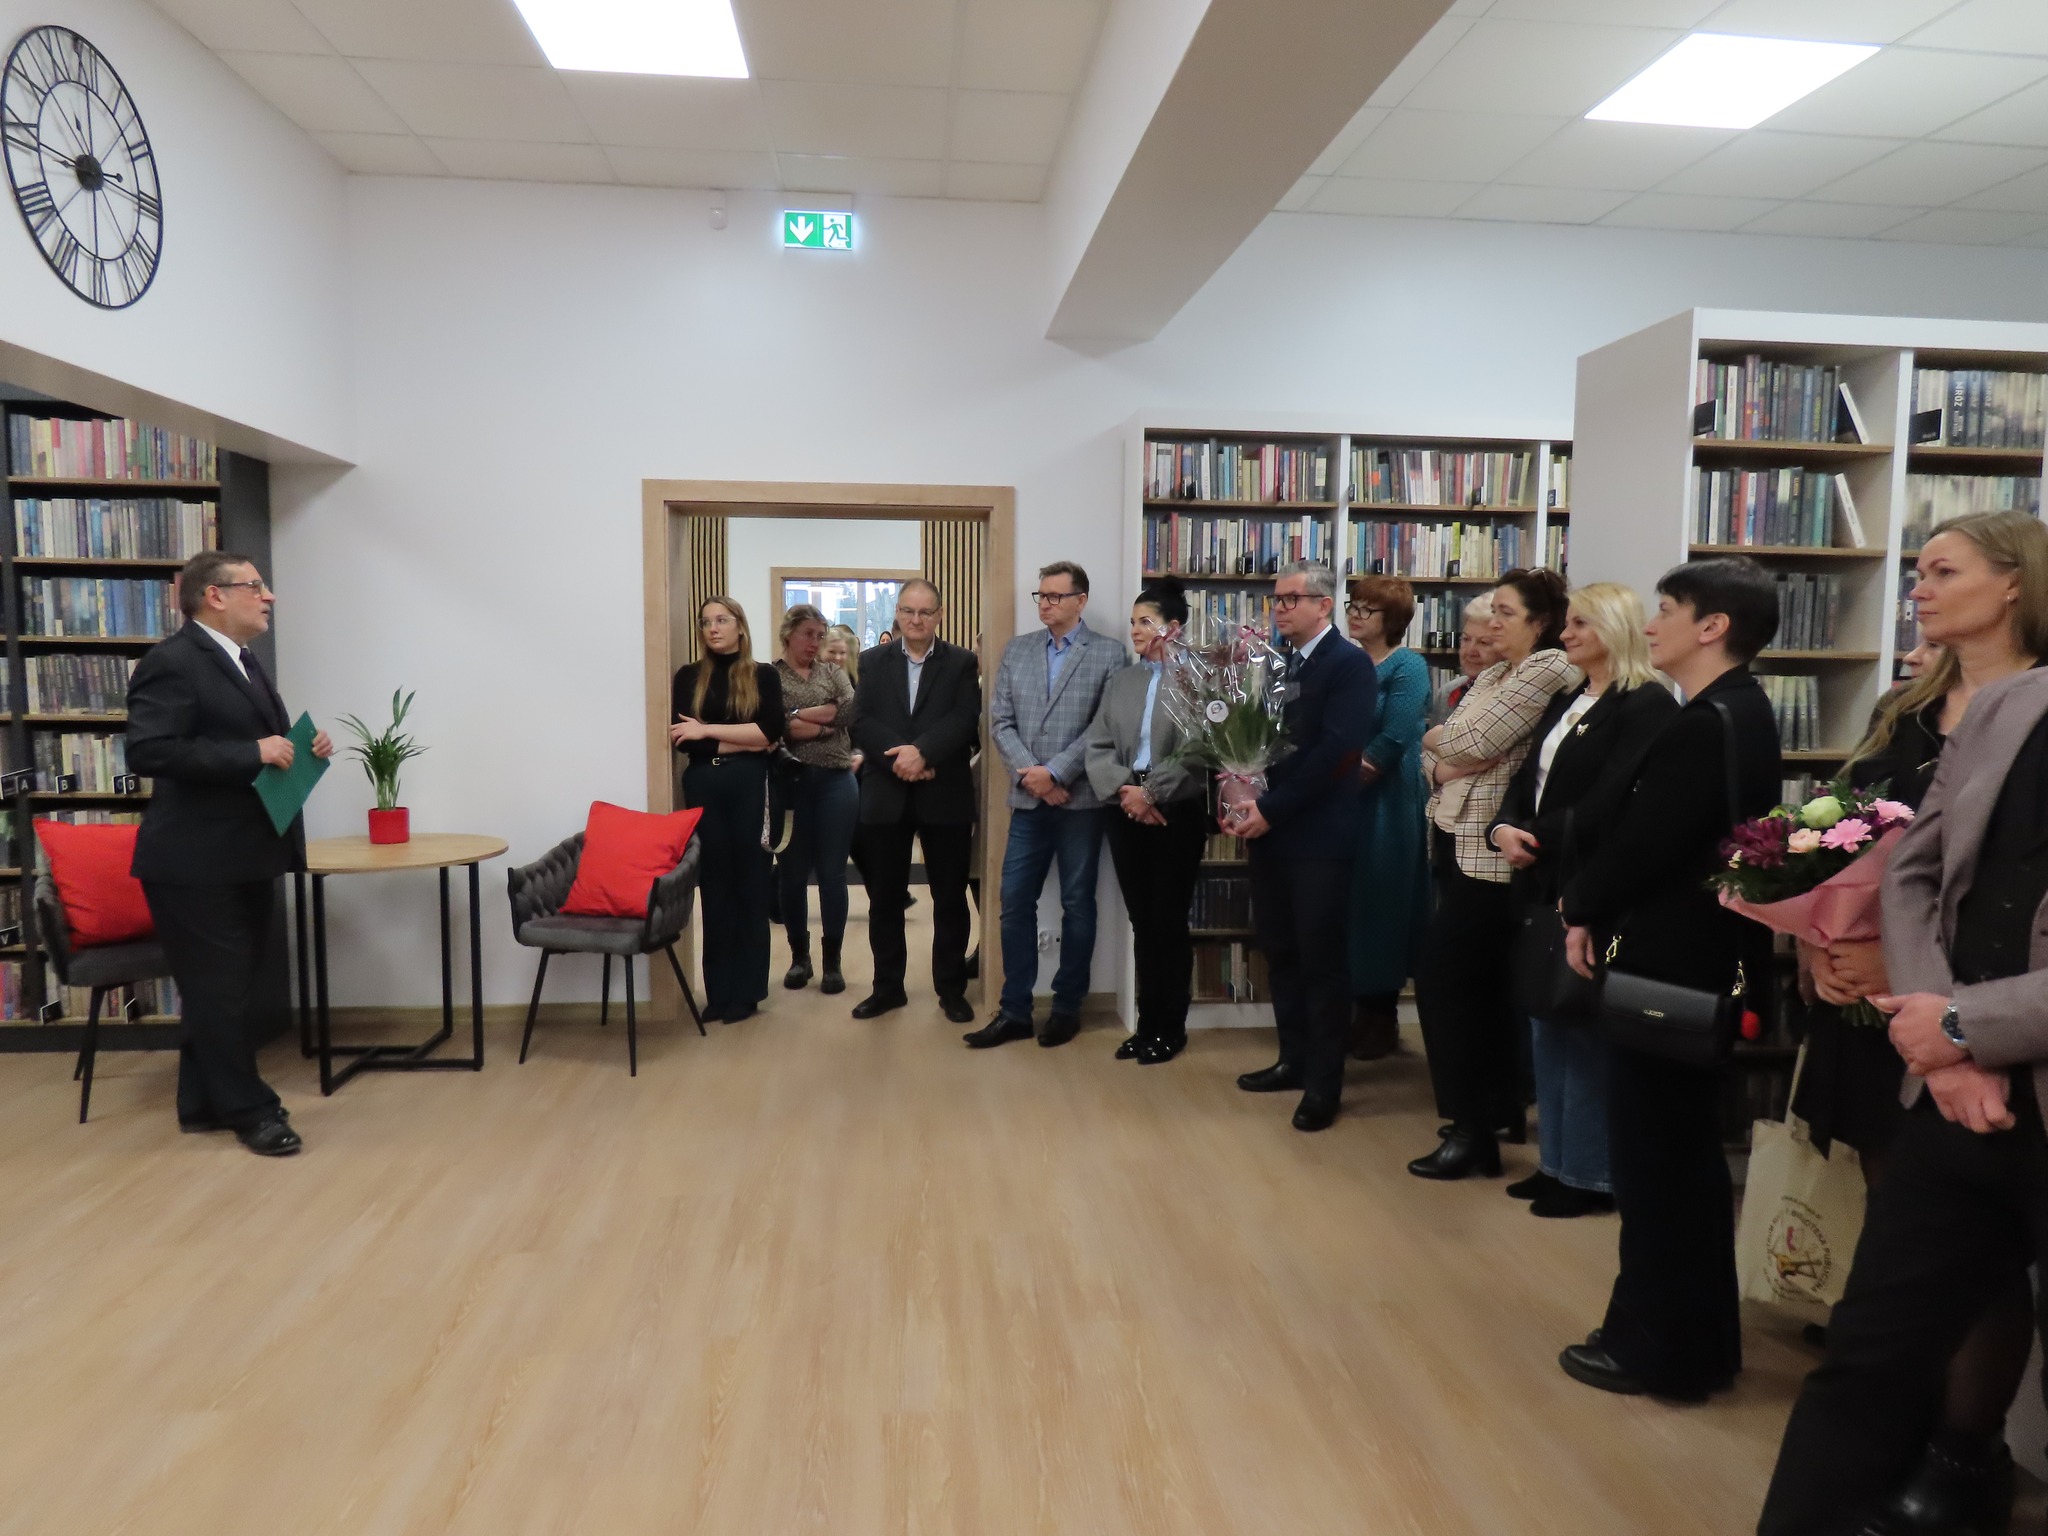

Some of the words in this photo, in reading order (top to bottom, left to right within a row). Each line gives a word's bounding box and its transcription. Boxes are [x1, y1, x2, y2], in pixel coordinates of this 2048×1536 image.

[1953, 381, 1964, 407] MRÓZ
[21, 779, 29, 791] A
[61, 779, 69, 791] B
[128, 779, 135, 791] D
